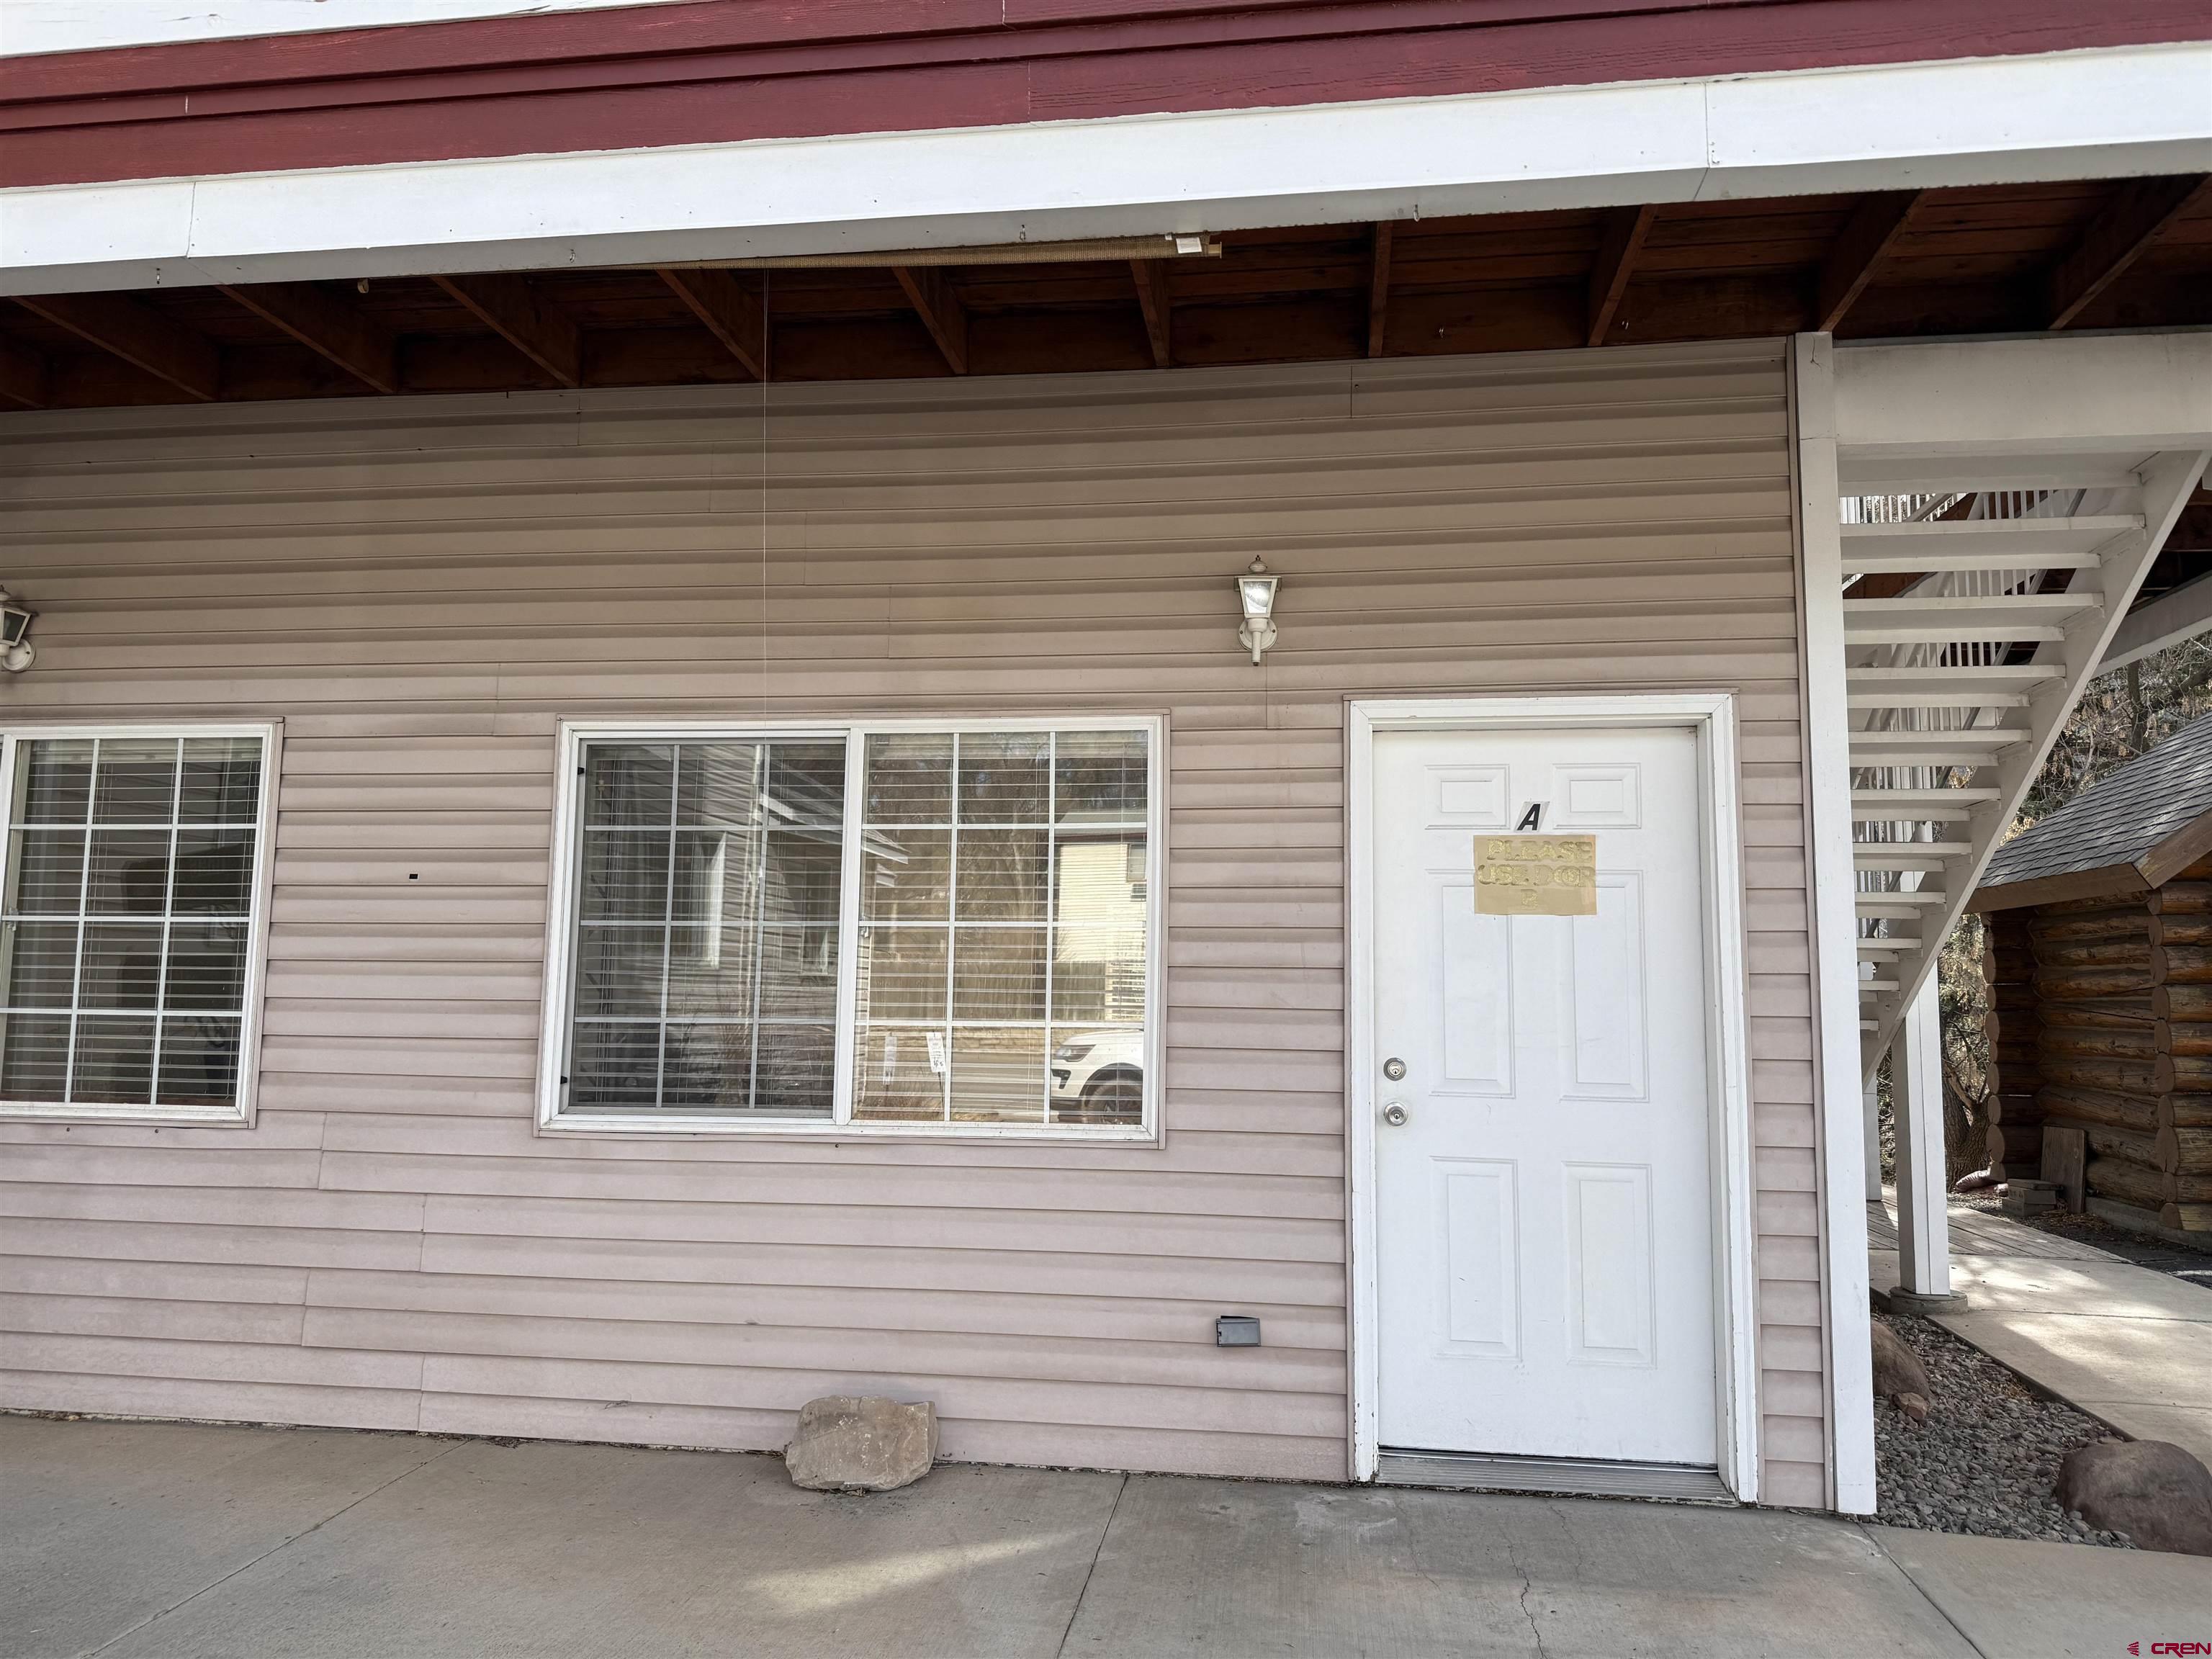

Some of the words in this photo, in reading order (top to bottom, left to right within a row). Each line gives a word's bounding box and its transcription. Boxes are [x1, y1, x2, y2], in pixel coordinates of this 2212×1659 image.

[1516, 804, 1541, 831] A
[1486, 839, 1593, 862] PLEASE
[1477, 864, 1529, 886] USE
[1532, 865, 1596, 887] DOOR
